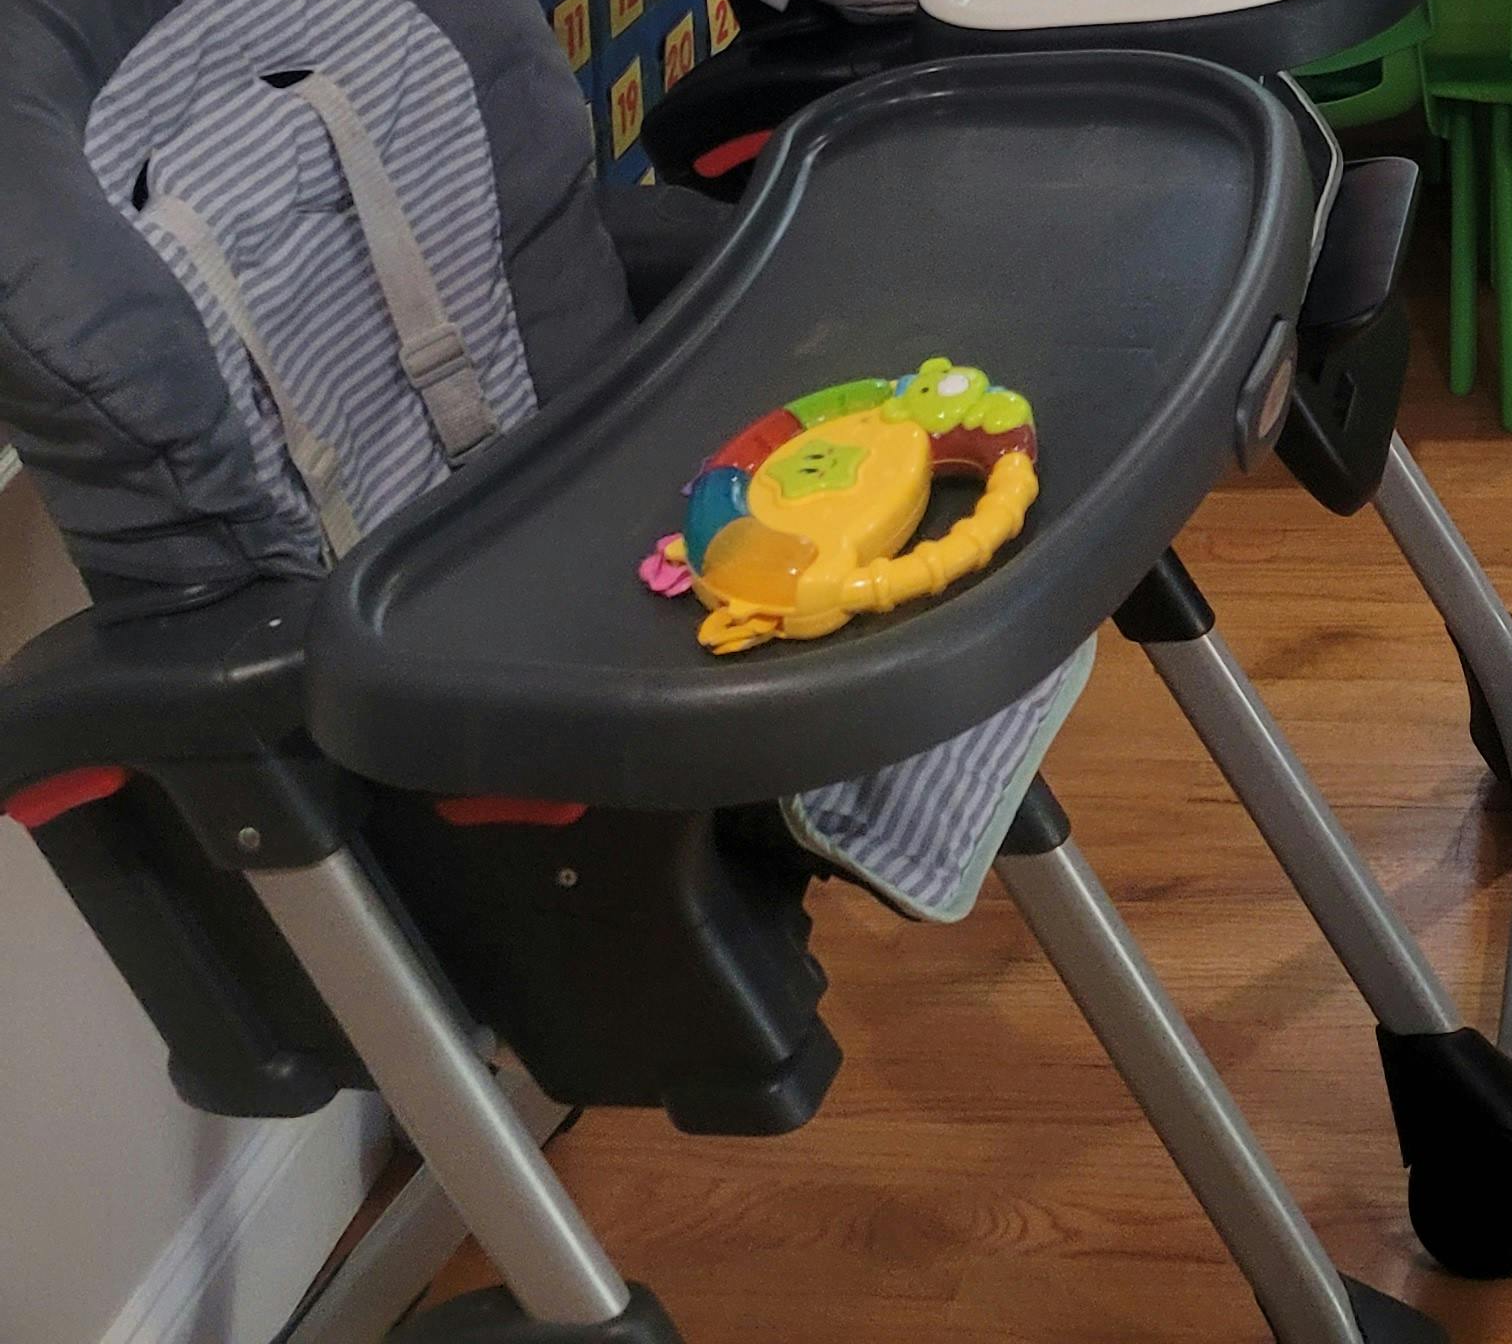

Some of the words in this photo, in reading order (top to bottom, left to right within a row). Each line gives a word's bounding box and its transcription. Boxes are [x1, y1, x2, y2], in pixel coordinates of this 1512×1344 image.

[564, 3, 587, 59] 11
[617, 76, 639, 136] 19
[667, 31, 693, 88] 20
